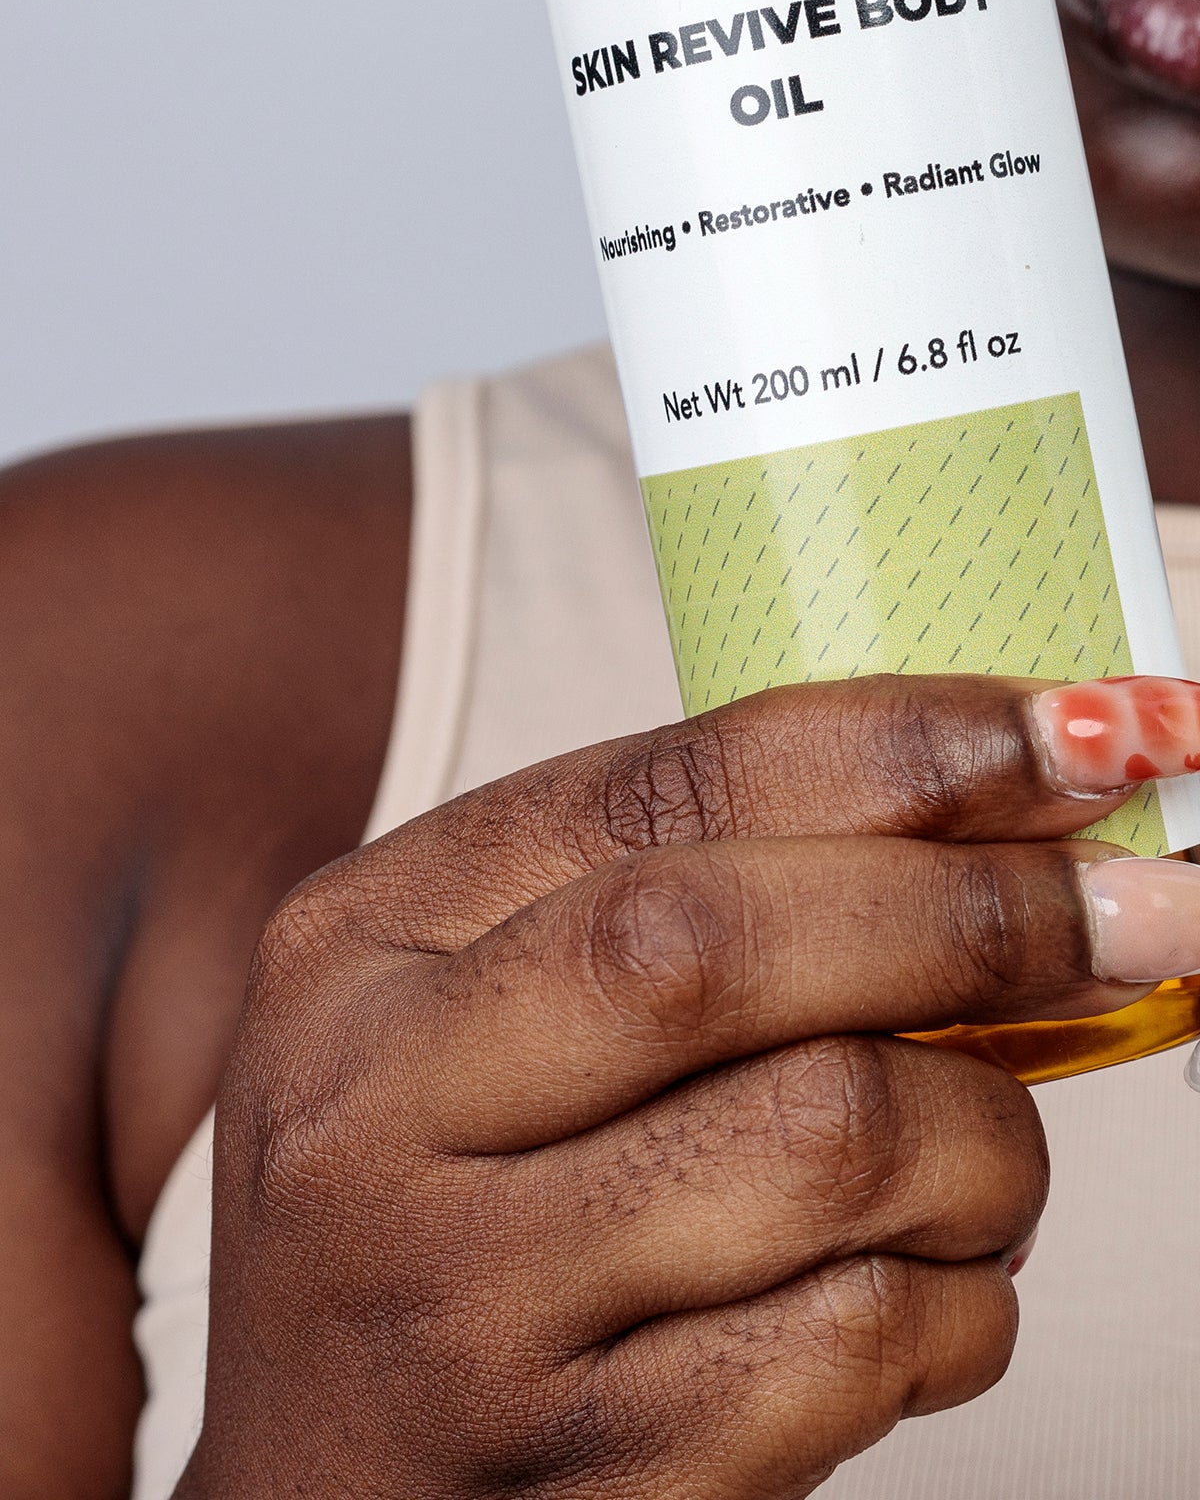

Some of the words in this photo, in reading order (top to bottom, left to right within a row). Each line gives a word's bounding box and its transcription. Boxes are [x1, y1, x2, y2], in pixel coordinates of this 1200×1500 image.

[571, 39, 641, 96] SKIN
[730, 74, 824, 126] OIL
[599, 224, 676, 261] Nourishing
[698, 188, 851, 237] Restorative
[882, 160, 985, 199] Radiant
[989, 150, 1040, 179] Glow
[663, 391, 703, 423] Net
[703, 379, 746, 414] Wt
[752, 366, 809, 405] 200
[820, 352, 861, 391] ml
[873, 347, 884, 383] /
[897, 337, 948, 375] 6.8
[956, 329, 978, 364] fl
[987, 332, 1022, 358] oz
